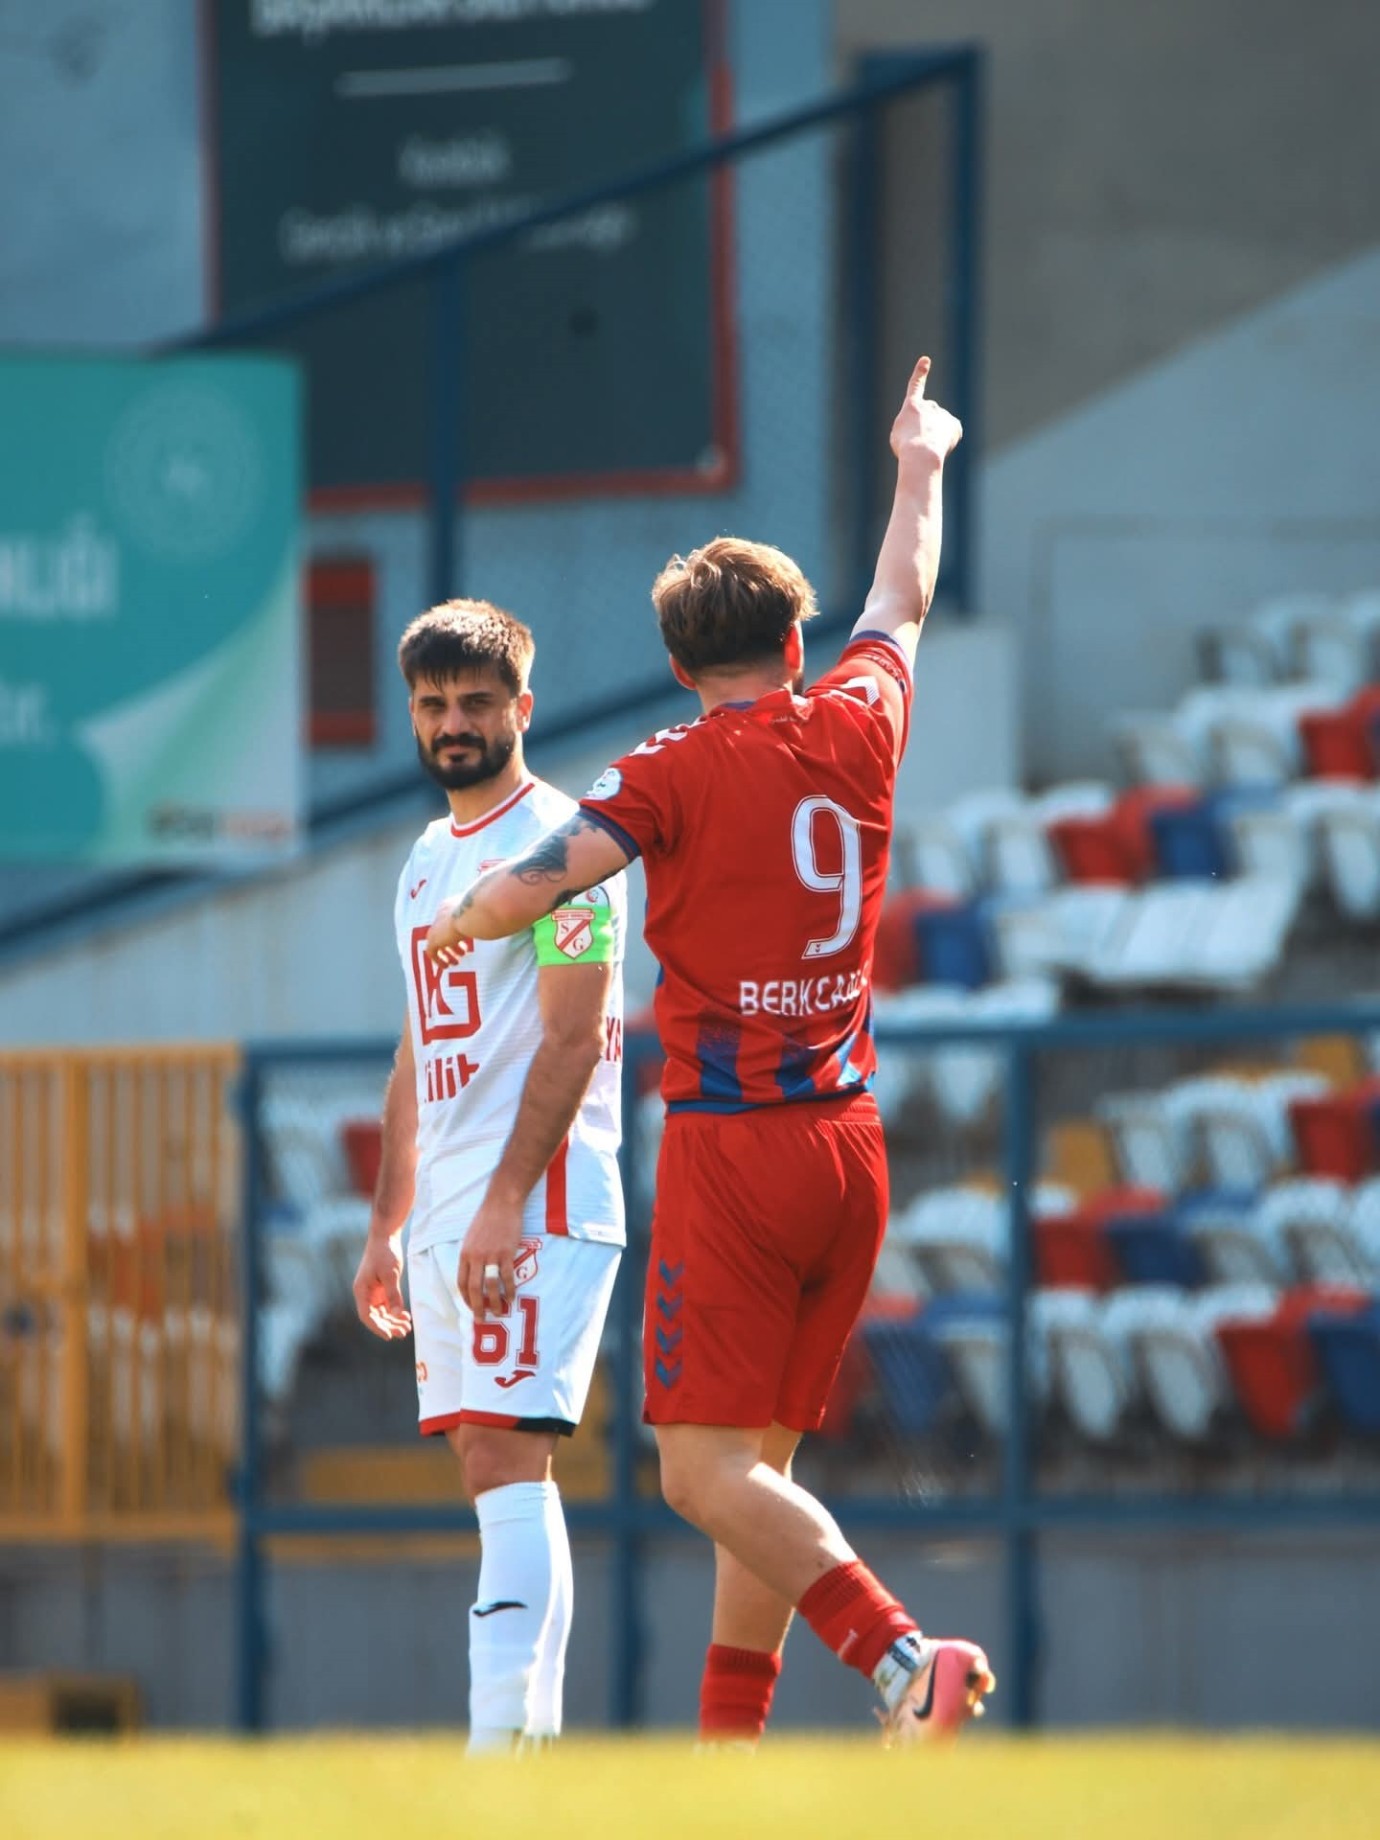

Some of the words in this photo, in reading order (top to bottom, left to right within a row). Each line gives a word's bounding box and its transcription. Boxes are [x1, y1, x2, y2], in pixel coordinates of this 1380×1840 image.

[790, 794, 863, 960] 9
[424, 1053, 480, 1103] ilit
[471, 1295, 540, 1369] 61
